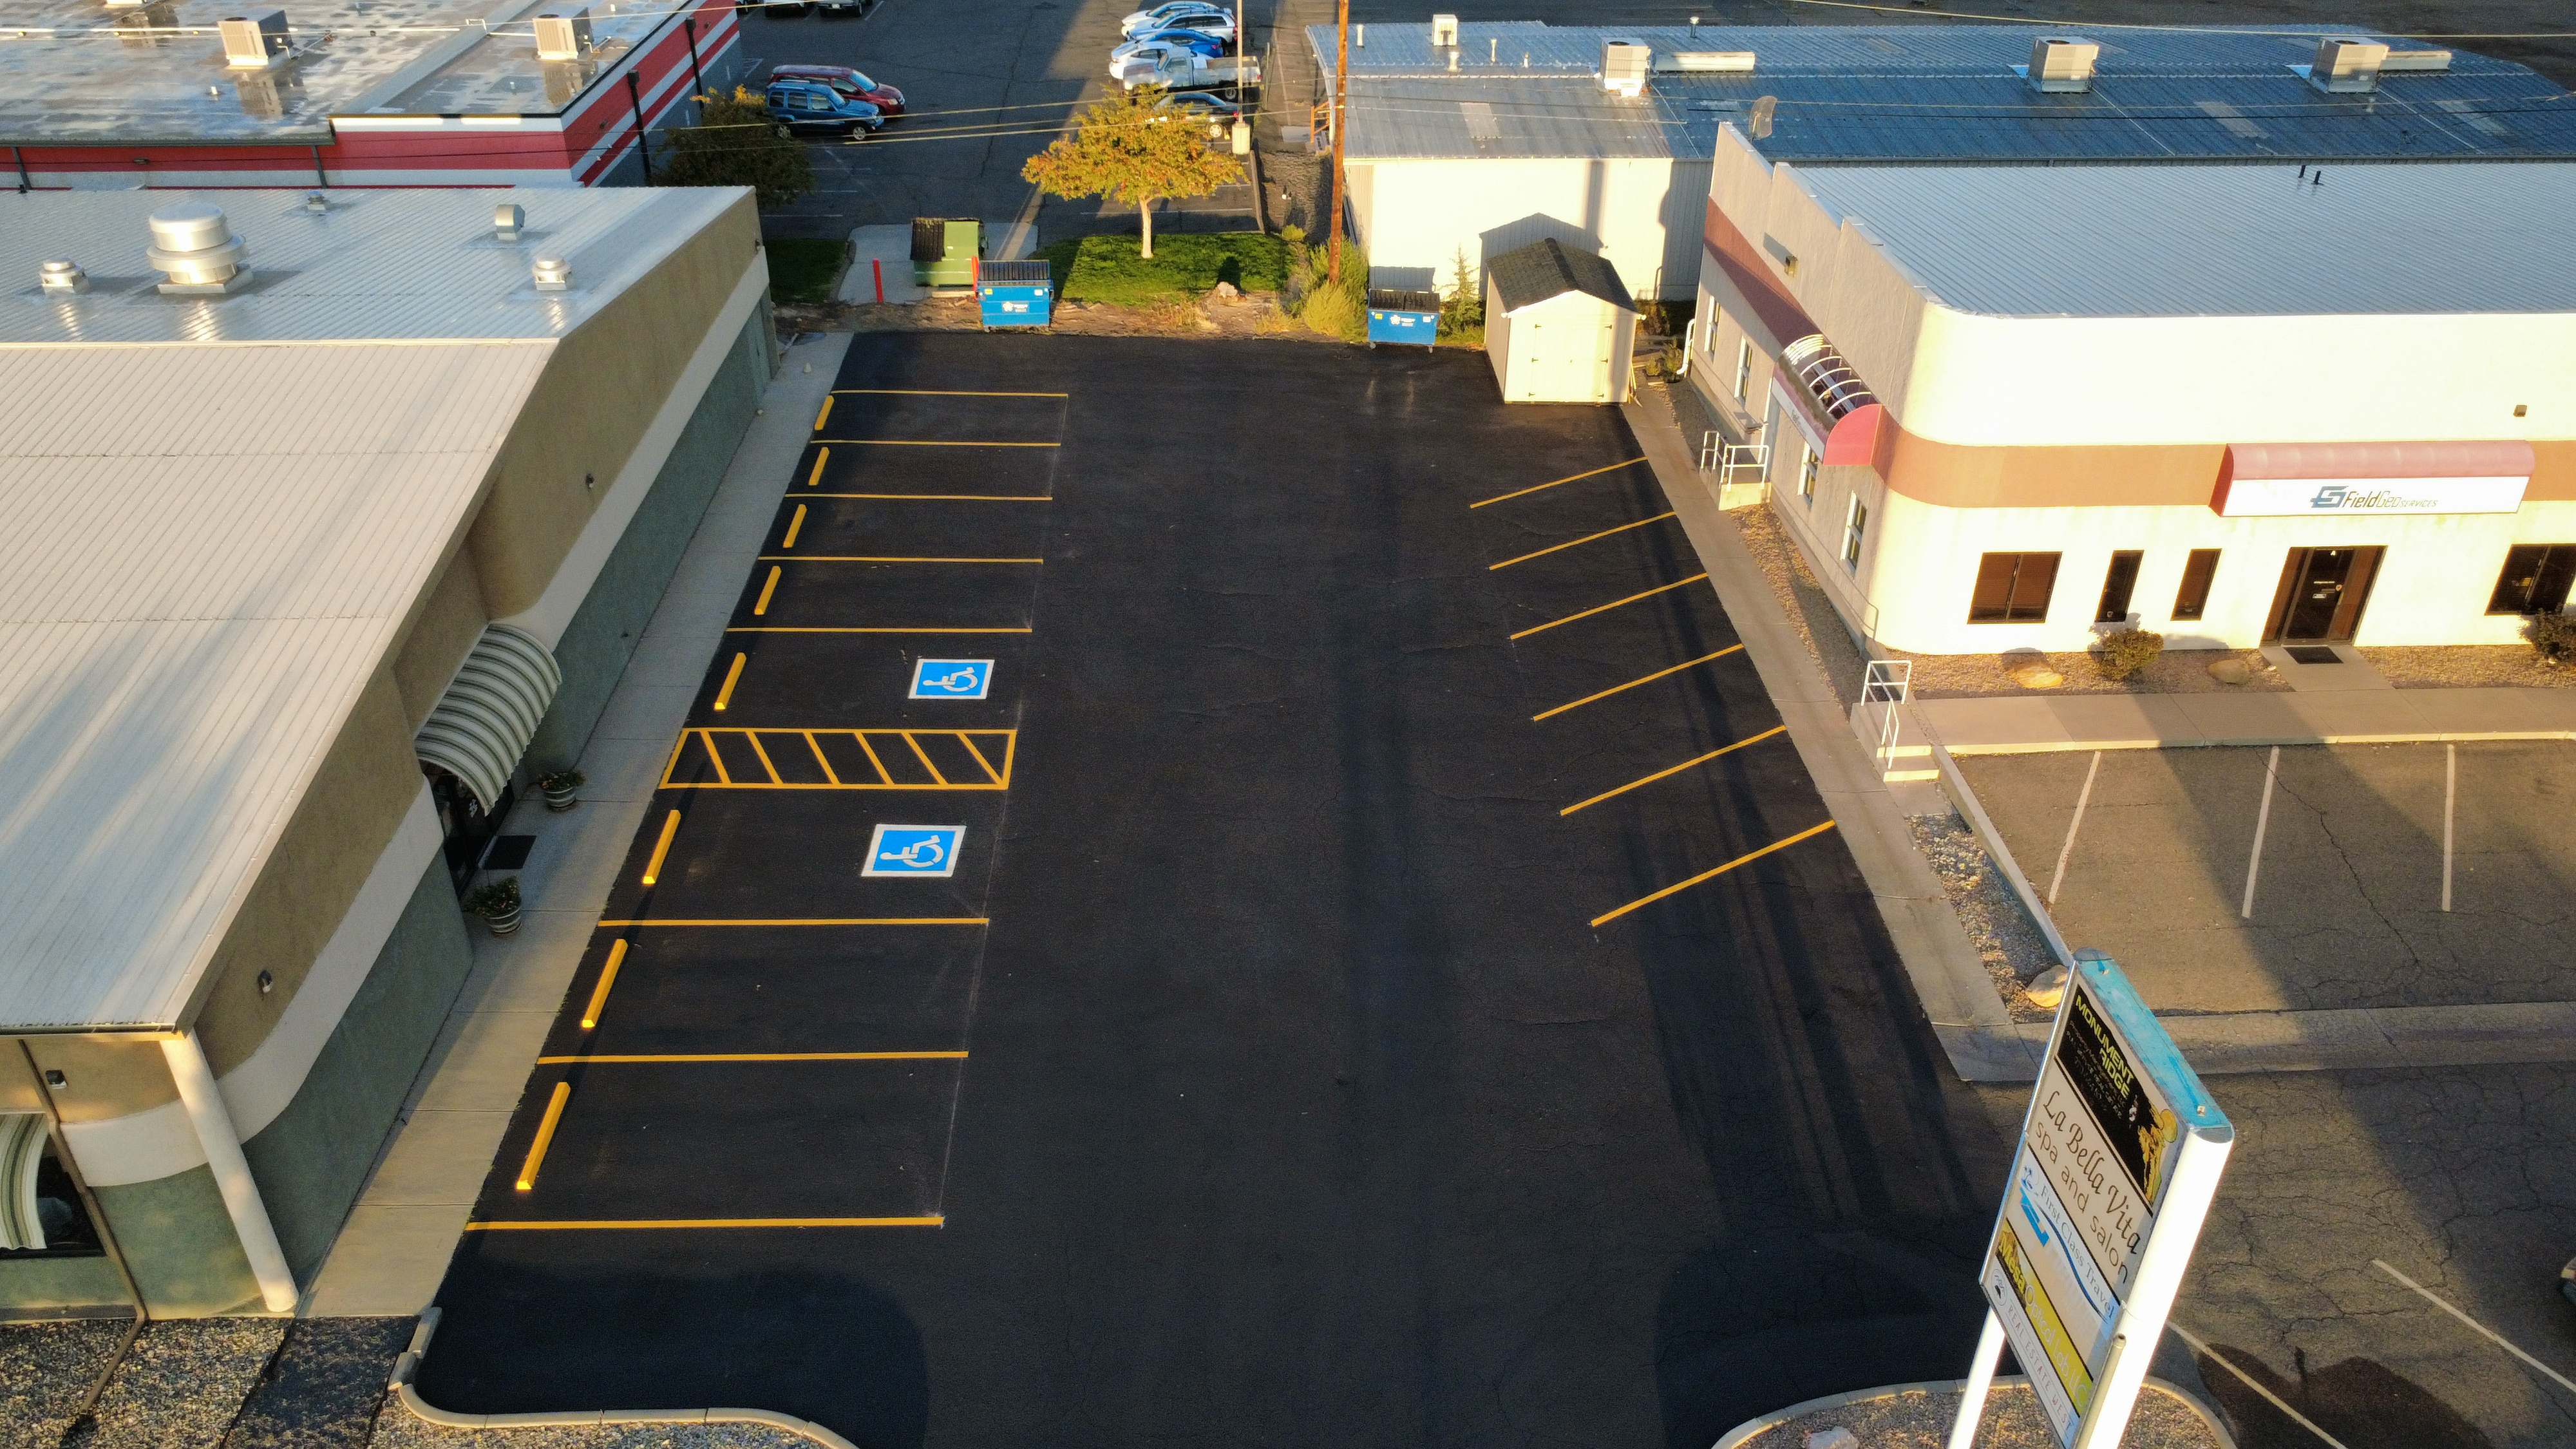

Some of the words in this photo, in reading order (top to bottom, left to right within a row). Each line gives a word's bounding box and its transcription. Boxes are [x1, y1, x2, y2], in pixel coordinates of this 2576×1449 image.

[2076, 995, 2134, 1084] MONUMENT
[2099, 1048, 2130, 1100] RIDGE
[2036, 1122, 2058, 1164] spa
[2061, 1166, 2089, 1213] and
[2090, 1215, 2128, 1283] salon
[2043, 1091, 2067, 1132] La
[2066, 1123, 2105, 1195] Bella
[2107, 1185, 2141, 1255] Vita
[2040, 1185, 2061, 1224] First
[2061, 1222, 2085, 1267] Class
[2086, 1262, 2116, 1319] Travel
[1998, 1231, 2027, 1294] Mesa
[2024, 1284, 2056, 1347] Optical
[2069, 1368, 2088, 1408] LLC
[2007, 1305, 2025, 1339] REAL
[2025, 1341, 2051, 1391] ESTATE
[2052, 1395, 2073, 1431] WEST
